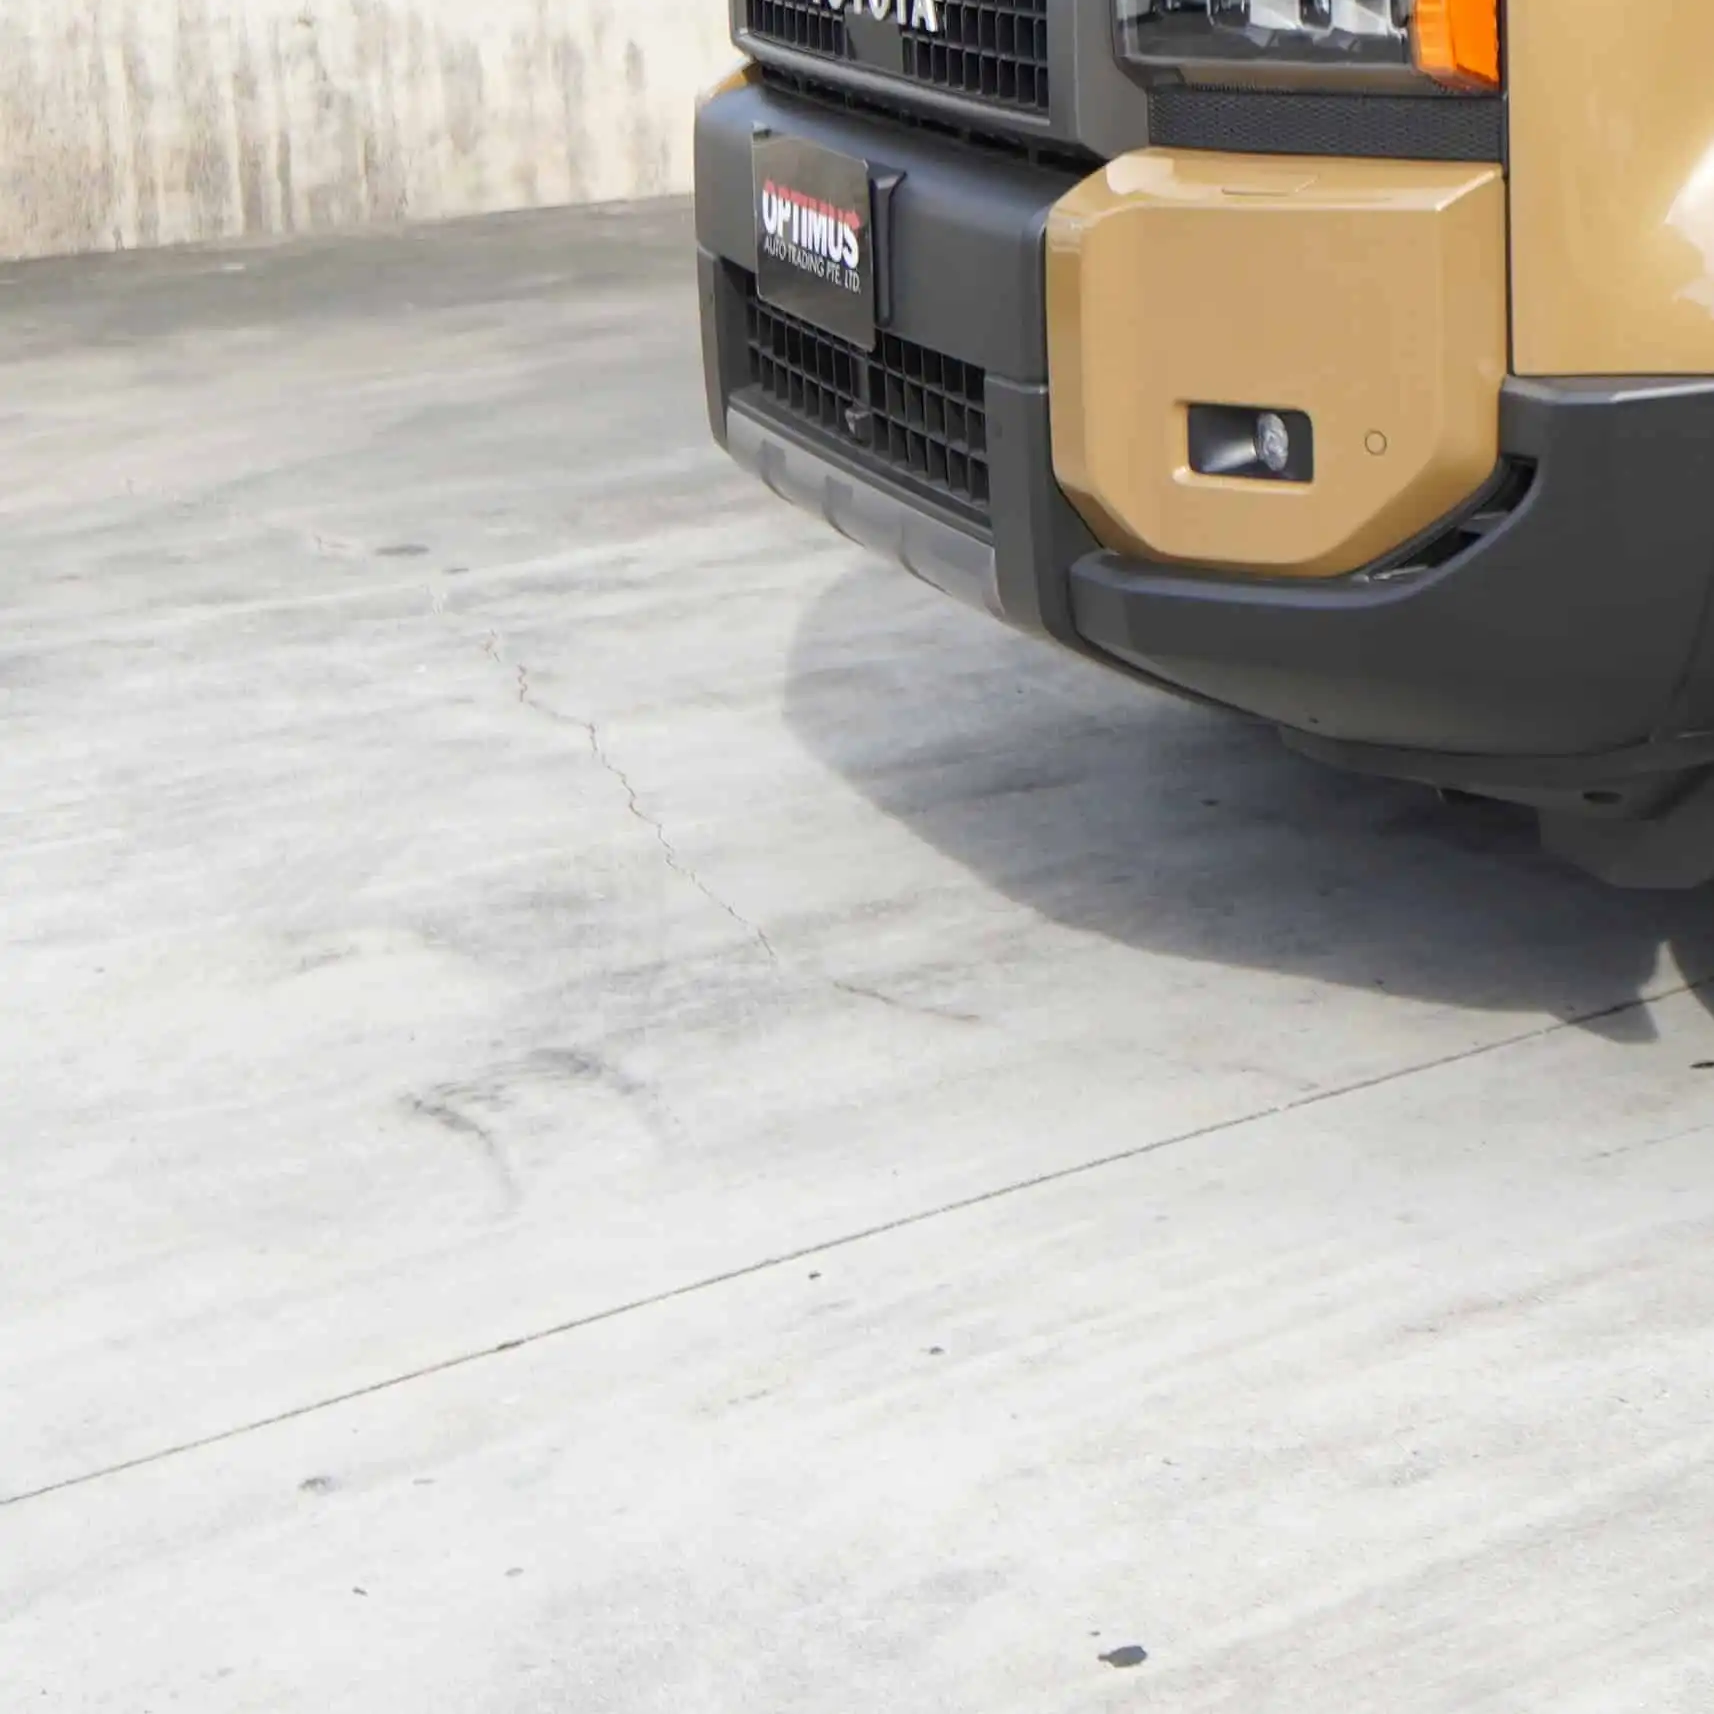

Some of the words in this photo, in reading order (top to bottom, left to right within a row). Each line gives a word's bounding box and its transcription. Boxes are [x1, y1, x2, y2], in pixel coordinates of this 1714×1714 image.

[762, 178, 862, 269] OPTIMUS
[764, 235, 787, 261] AUTO
[788, 243, 825, 278] TRADING
[845, 269, 861, 294] LTD.
